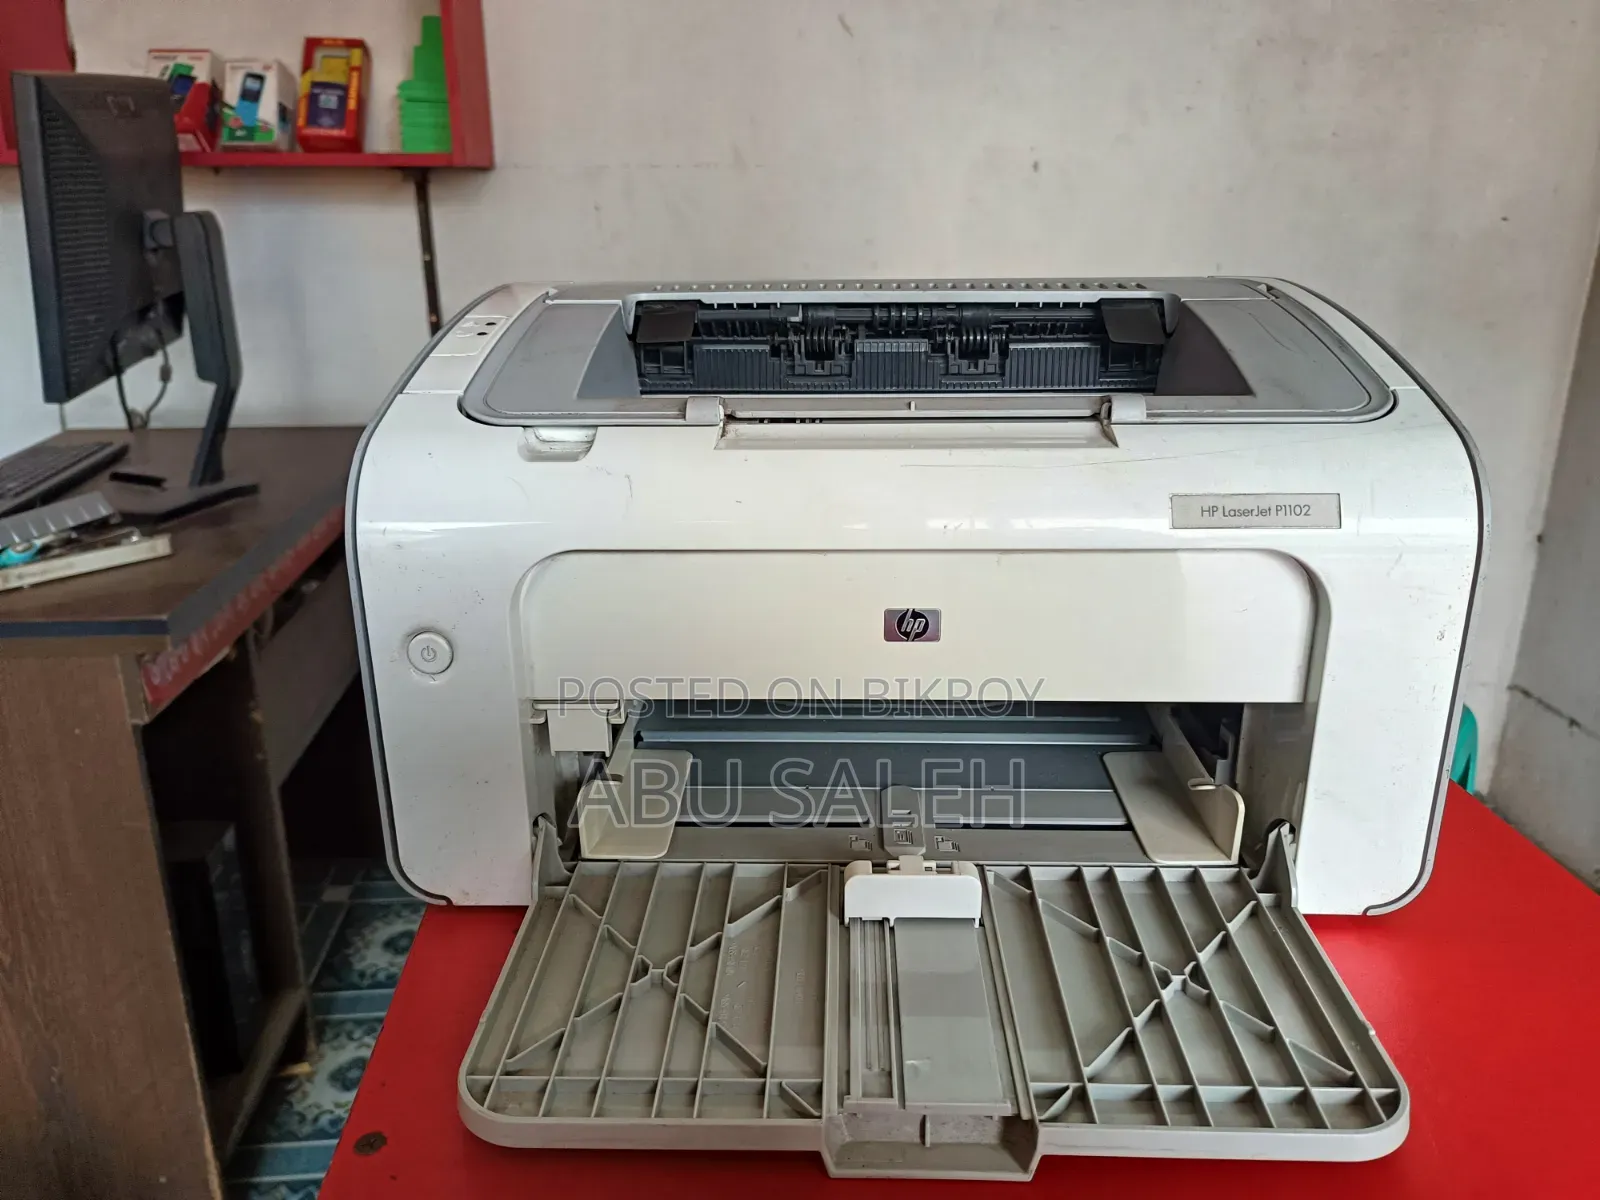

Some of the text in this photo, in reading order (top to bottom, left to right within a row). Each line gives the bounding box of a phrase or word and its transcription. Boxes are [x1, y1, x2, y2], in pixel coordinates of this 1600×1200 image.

[1200, 504, 1311, 518] HP LaserJet P1102
[900, 608, 926, 642] hp
